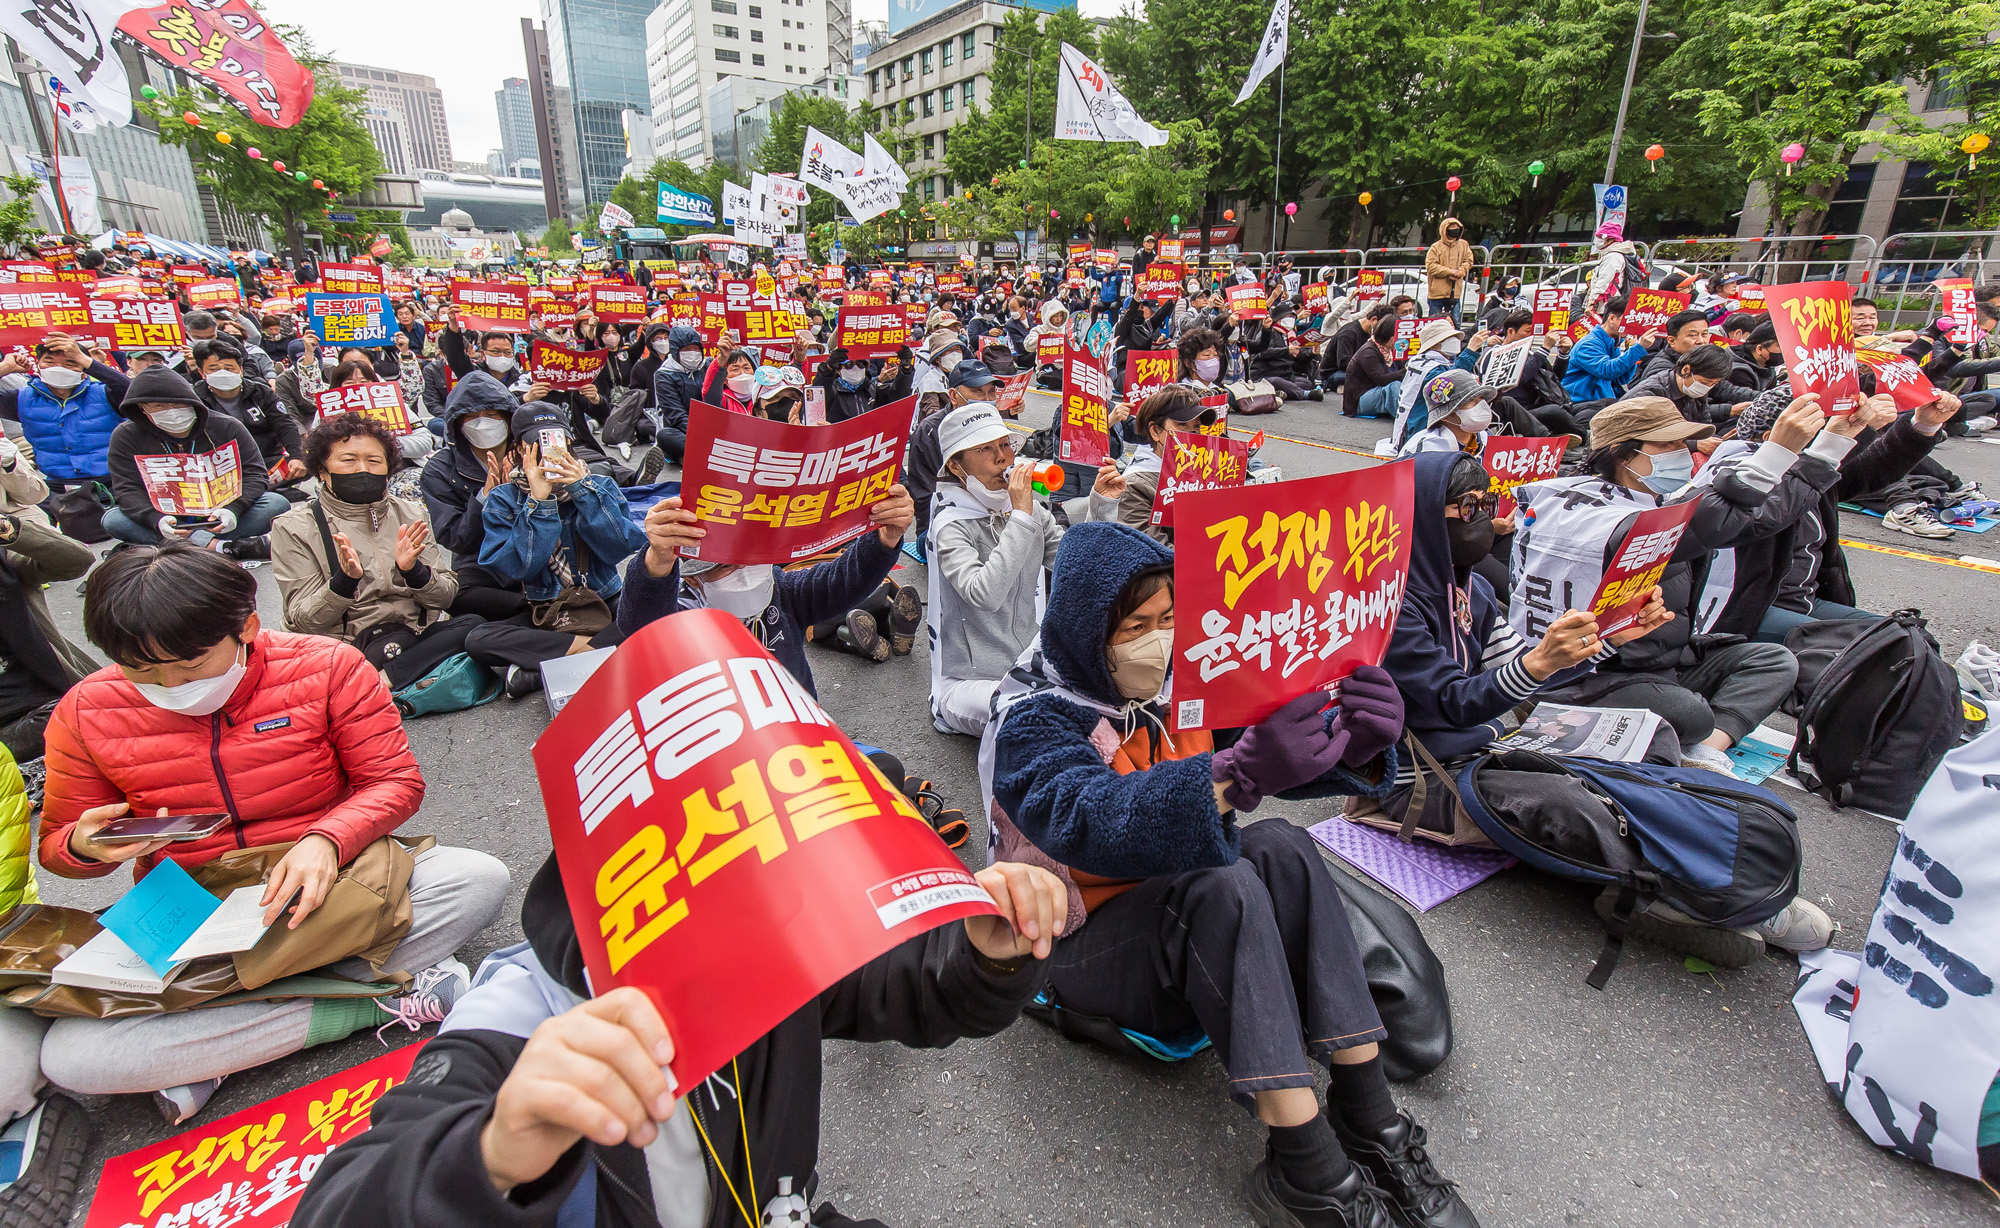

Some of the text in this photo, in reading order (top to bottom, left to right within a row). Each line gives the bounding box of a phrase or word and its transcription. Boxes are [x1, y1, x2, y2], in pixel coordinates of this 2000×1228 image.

[147, 6, 281, 119] 촛불이다
[661, 191, 711, 213] 양희삼TV
[711, 243, 730, 251] 1200
[324, 269, 379, 283] 특등매국노
[325, 280, 381, 294] 윤석열 퇴진
[0, 292, 82, 310] 등매국노
[459, 289, 524, 306] 특등매국노
[596, 290, 643, 302] 특등매국노
[1232, 298, 1257, 311] 윤석열
[1636, 293, 1684, 315] 전쟁 부르는
[50, 310, 89, 326] 퇴진
[89, 300, 178, 324] 윤석열
[460, 304, 526, 320] 윤석열 퇴진
[596, 302, 646, 313] 윤석열 퇴진
[671, 303, 694, 318] 전쟁
[324, 313, 381, 329] 윤석열을
[844, 314, 902, 330] 특등매국노
[1780, 295, 1839, 346] 전쟁
[114, 322, 182, 346] 퇴진!
[325, 326, 387, 342] 타도하자!
[842, 329, 904, 346] 윤석열 퇴진
[540, 348, 602, 371] 전쟁 부르는
[1039, 346, 1059, 356] 윤석열
[1135, 358, 1171, 384] 전쟁
[320, 385, 400, 416] 윤석열
[1067, 394, 1109, 435] 윤석열
[143, 442, 237, 482] 윤석열
[707, 432, 898, 488] 특등매국노
[1174, 443, 1241, 482] 전쟁 부르는
[1491, 449, 1535, 477] 미국의
[696, 464, 897, 528] 윤석열 퇴진
[1205, 500, 1402, 611] 전쟁 부르는
[1184, 598, 1320, 684] 윤석열을
[258, 721, 288, 732] patagonia
[1606, 714, 1632, 747] 노동자 연대
[595, 740, 881, 977] 윤석열
[133, 1112, 287, 1219] 전쟁
